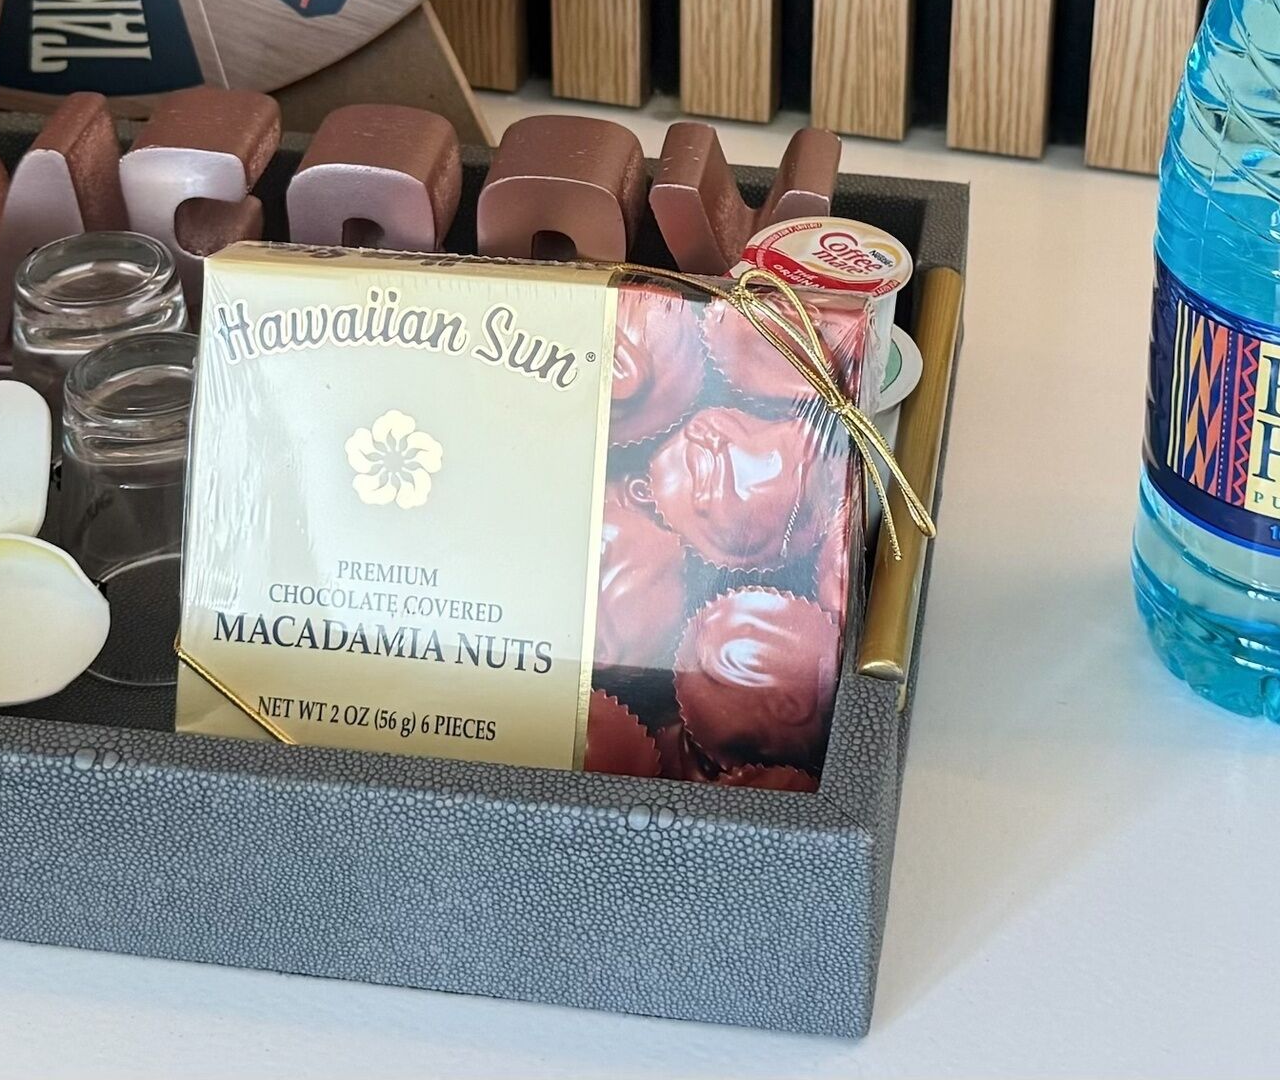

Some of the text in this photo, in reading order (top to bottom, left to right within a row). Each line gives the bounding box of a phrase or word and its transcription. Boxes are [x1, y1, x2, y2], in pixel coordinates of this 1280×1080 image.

[818, 231, 883, 273] Coffee
[773, 264, 828, 290] ORIGINA
[795, 268, 818, 280] THE
[218, 289, 580, 389] Hawaiian Sun
[337, 559, 440, 588] PREMIUM
[269, 583, 503, 623] CHOCOLATE COVERED
[213, 610, 554, 675] MACADAMIA NUTS
[257, 695, 497, 742] NET WT 2 OZ (56 g) 6 PIECES
